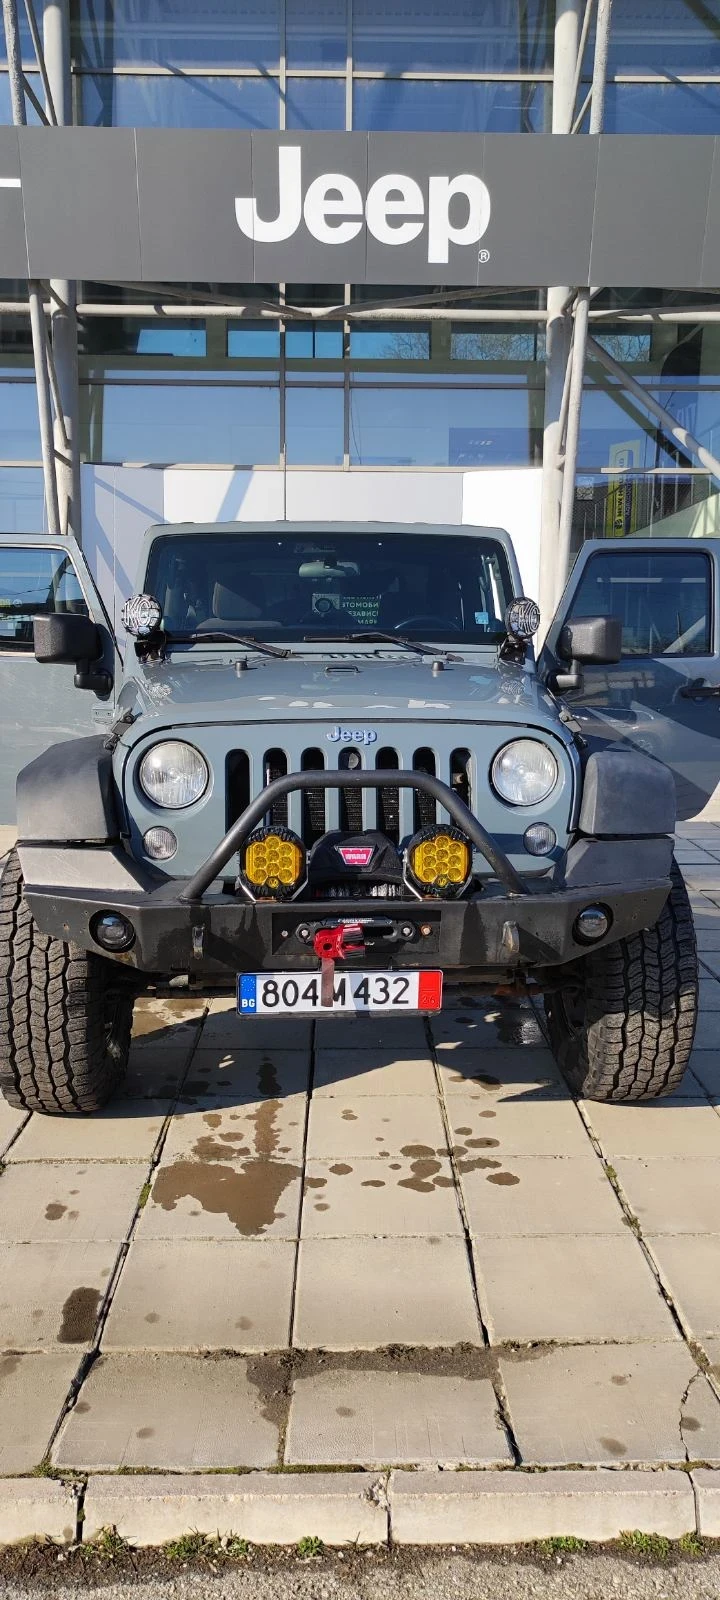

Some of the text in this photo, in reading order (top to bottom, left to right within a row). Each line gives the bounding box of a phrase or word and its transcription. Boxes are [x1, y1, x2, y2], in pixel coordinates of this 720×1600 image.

[234, 146, 491, 264] Jeep
[326, 726, 378, 746] Jeep
[241, 998, 256, 1008] BG
[261, 978, 319, 1008] 804
[353, 976, 410, 1005] 432
